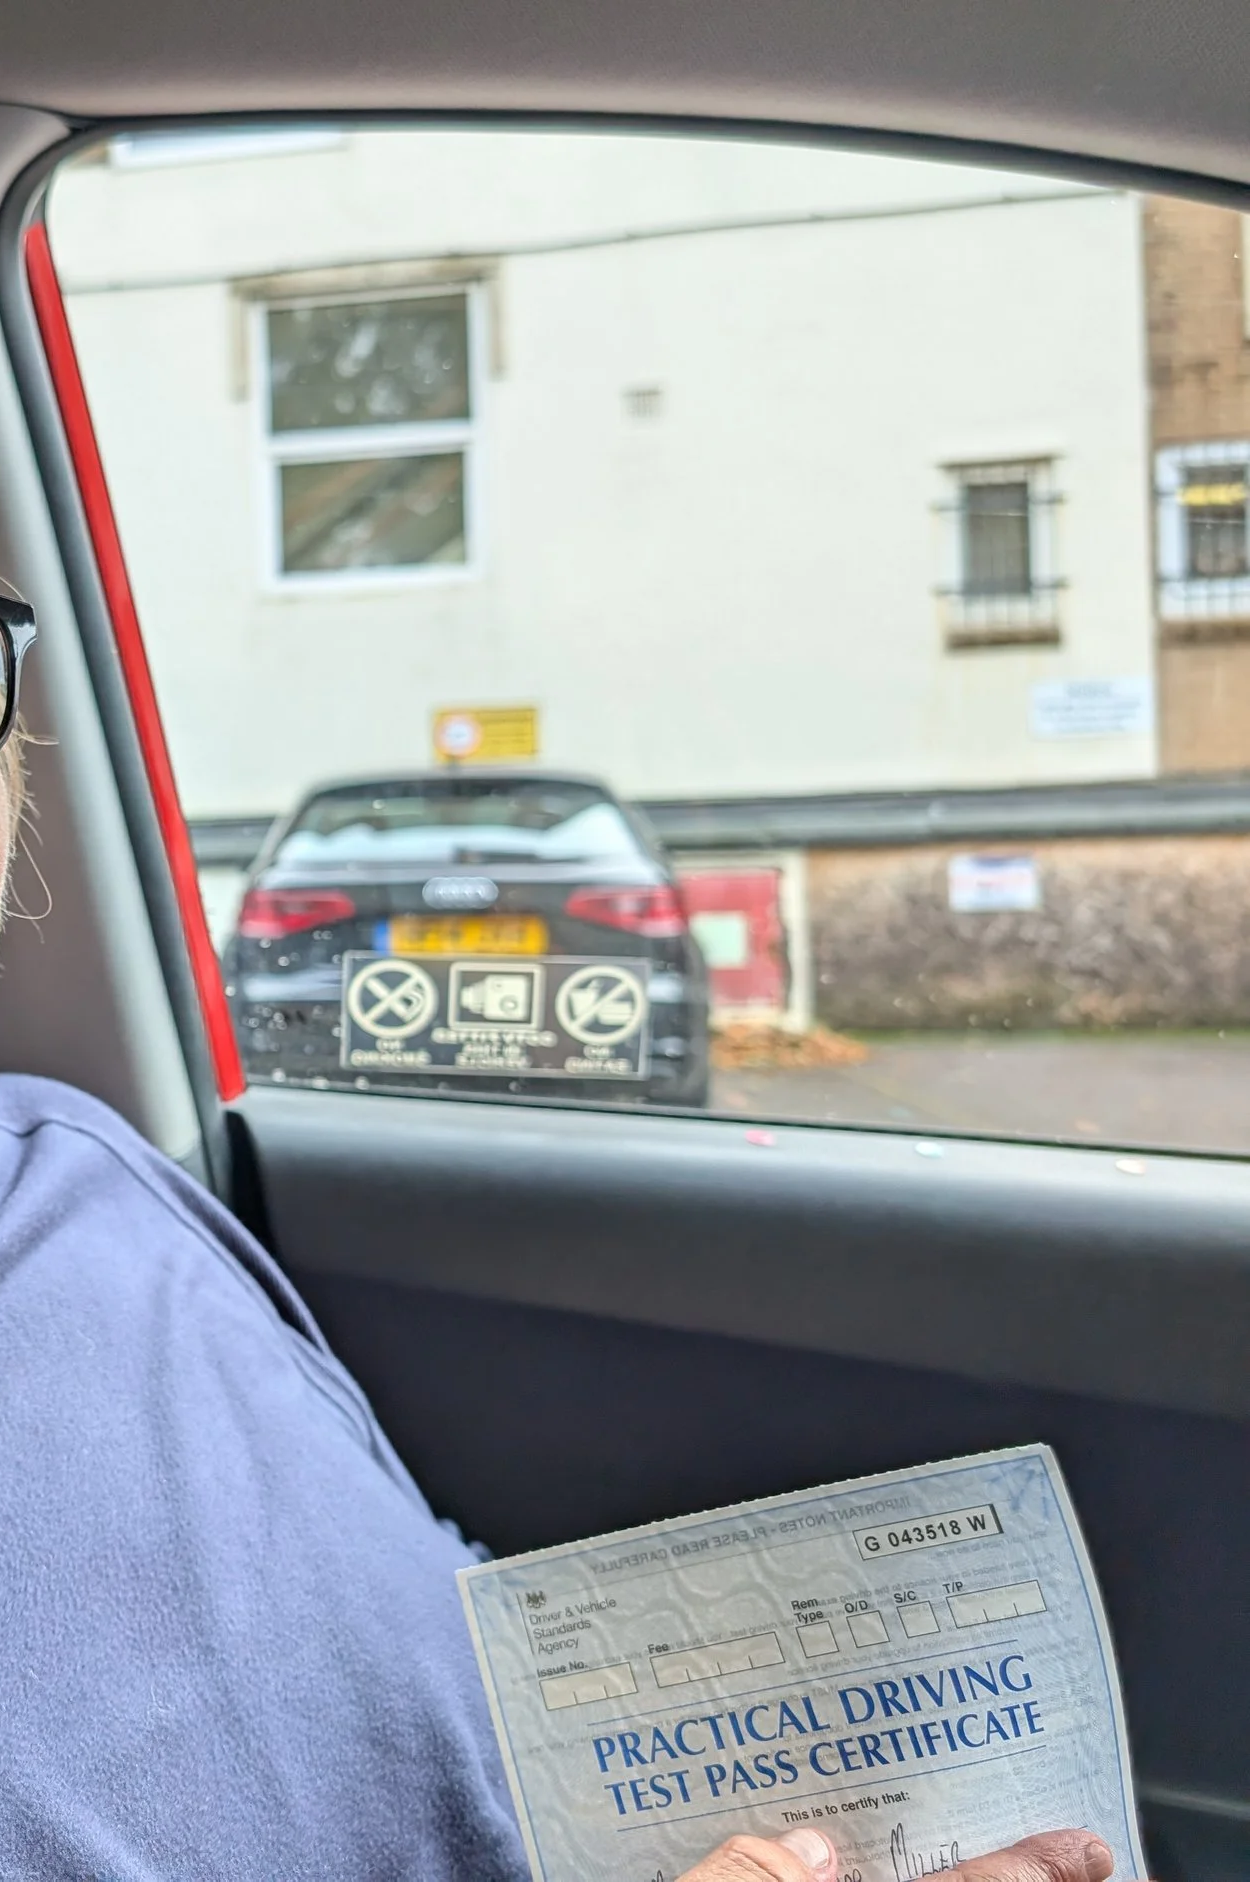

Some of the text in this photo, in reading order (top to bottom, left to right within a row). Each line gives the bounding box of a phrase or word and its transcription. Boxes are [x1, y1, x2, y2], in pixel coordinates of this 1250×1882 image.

[865, 1514, 986, 1552] G 043518 W
[942, 1581, 963, 1594] T/P
[791, 1597, 819, 1611] Rem
[893, 1590, 916, 1604] S/C
[529, 1598, 617, 1625] Driver & Vehicle
[844, 1600, 868, 1614] O/D
[794, 1609, 824, 1624] Type
[532, 1618, 592, 1640] Standards
[537, 1637, 579, 1656] Agency
[647, 1642, 669, 1653] Fee
[537, 1660, 589, 1678] Issue No.
[592, 1654, 1033, 1773] PRACTICAL DRIVING
[604, 1769, 691, 1815] TEST
[704, 1750, 799, 1798] PASS
[809, 1700, 1044, 1776] CERTIFICATE
[781, 1790, 910, 1824] This is to certify that:
